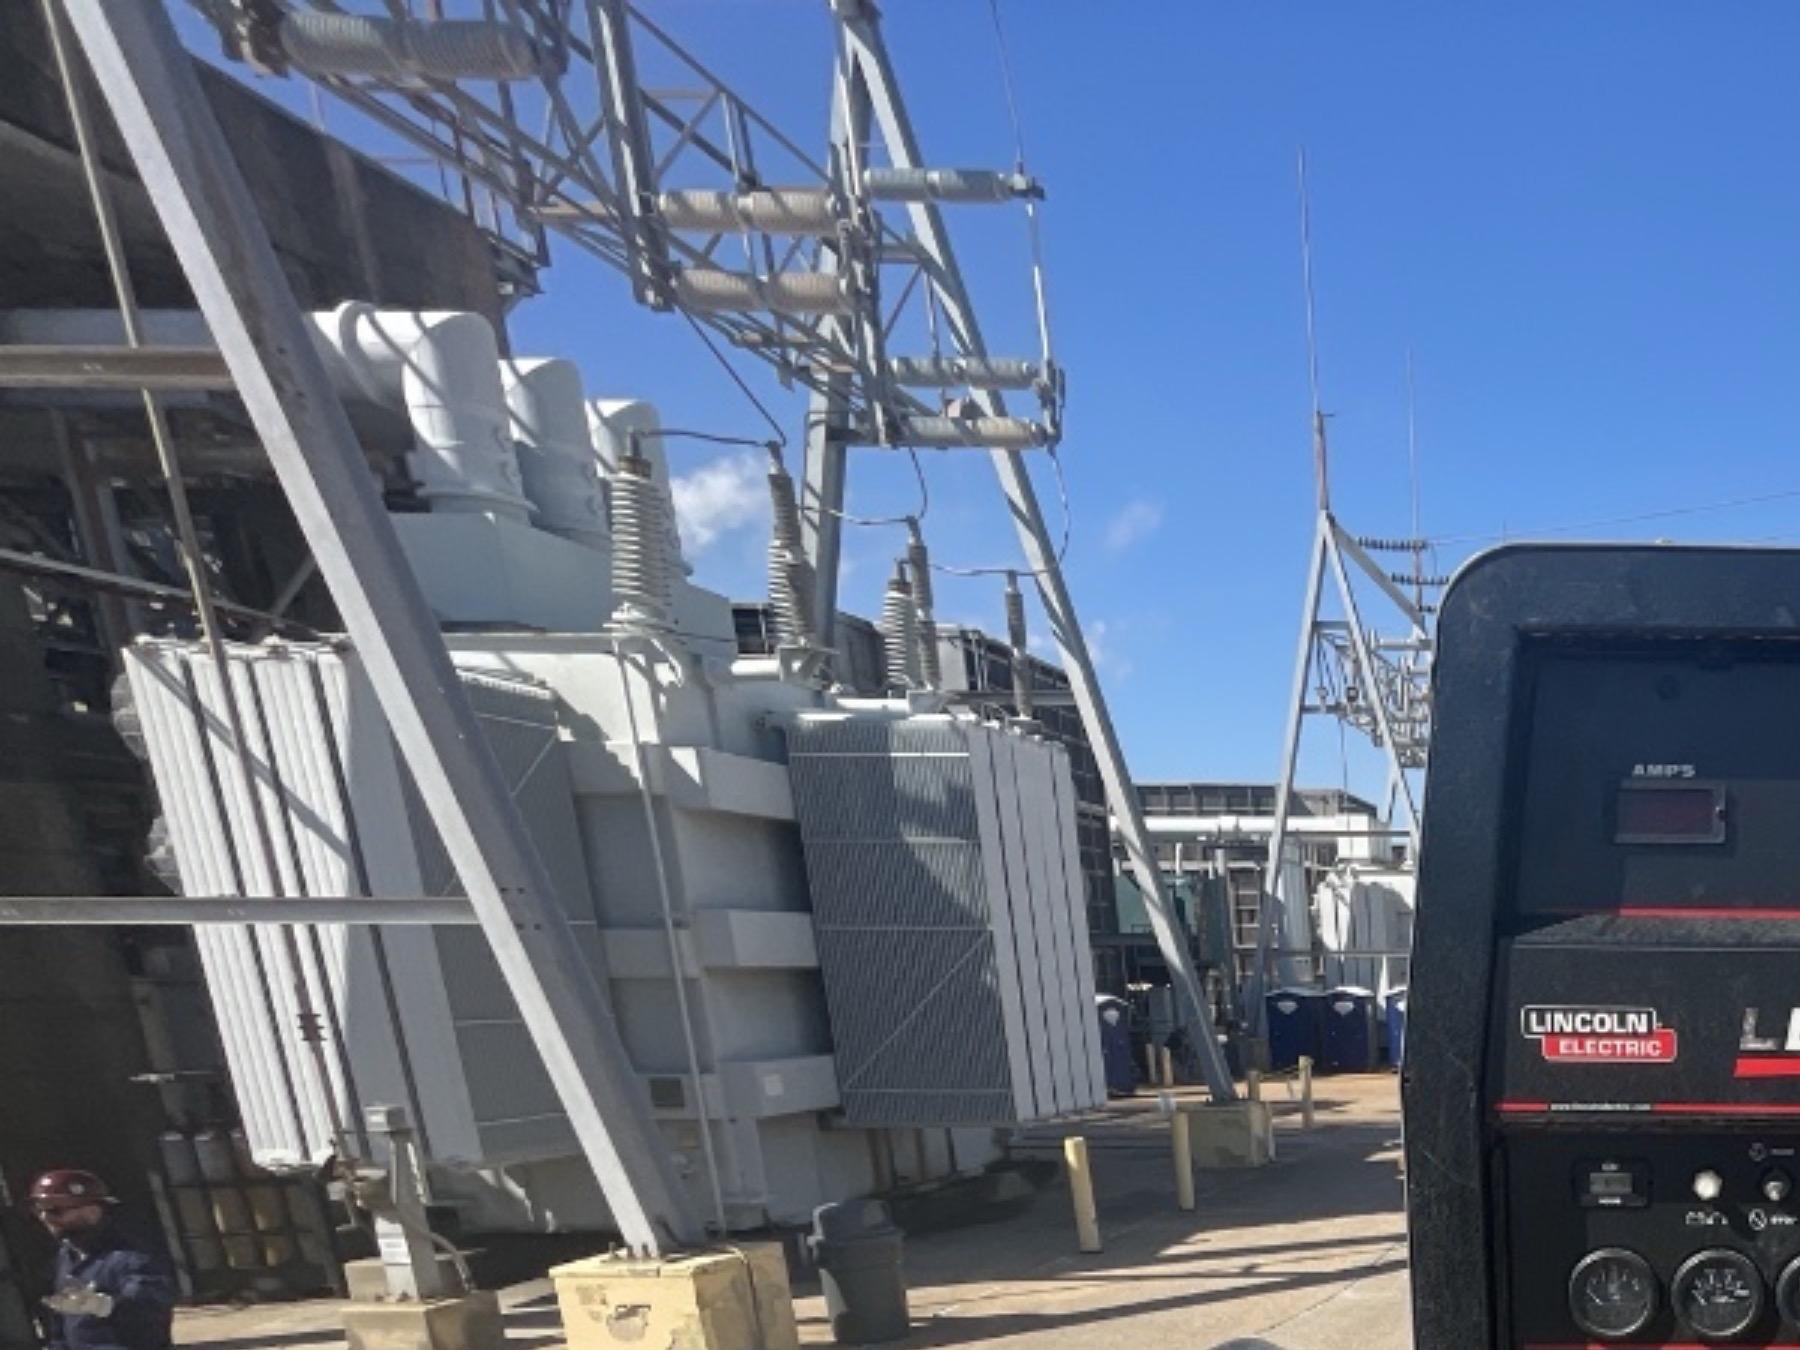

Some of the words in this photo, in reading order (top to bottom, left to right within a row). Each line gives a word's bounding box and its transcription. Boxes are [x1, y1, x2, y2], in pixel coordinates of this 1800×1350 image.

[1632, 763, 1695, 778] AMPS
[1529, 1011, 1648, 1034] LINCOLN
[1558, 1039, 1663, 1057] ELECTRIC
